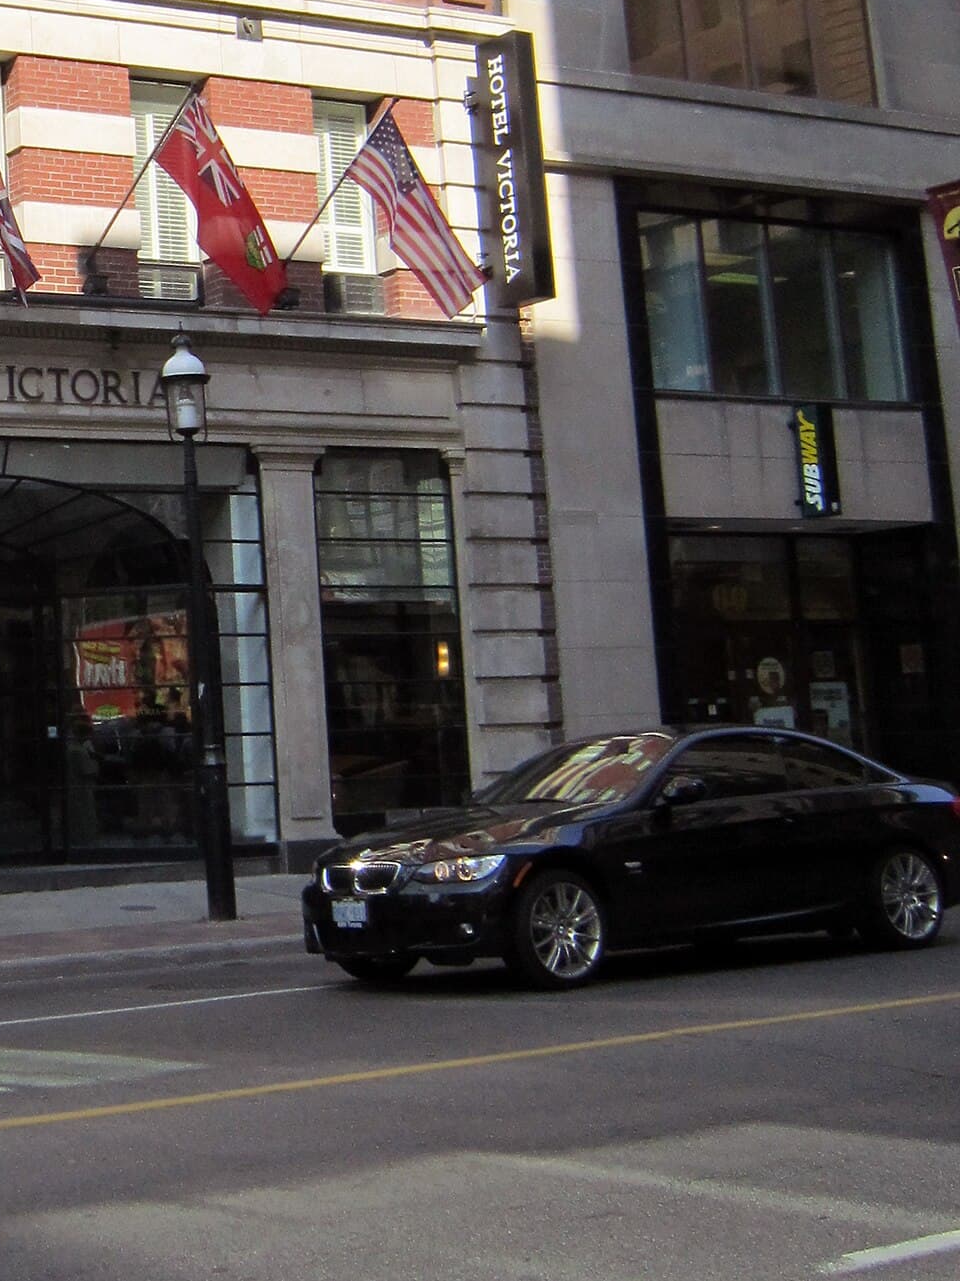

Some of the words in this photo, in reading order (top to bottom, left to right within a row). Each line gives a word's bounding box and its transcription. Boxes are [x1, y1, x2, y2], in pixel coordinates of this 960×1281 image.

[487, 54, 509, 146] HOTEL
[496, 148, 521, 285] VICTORIA
[796, 409, 824, 512] SUBWAY
